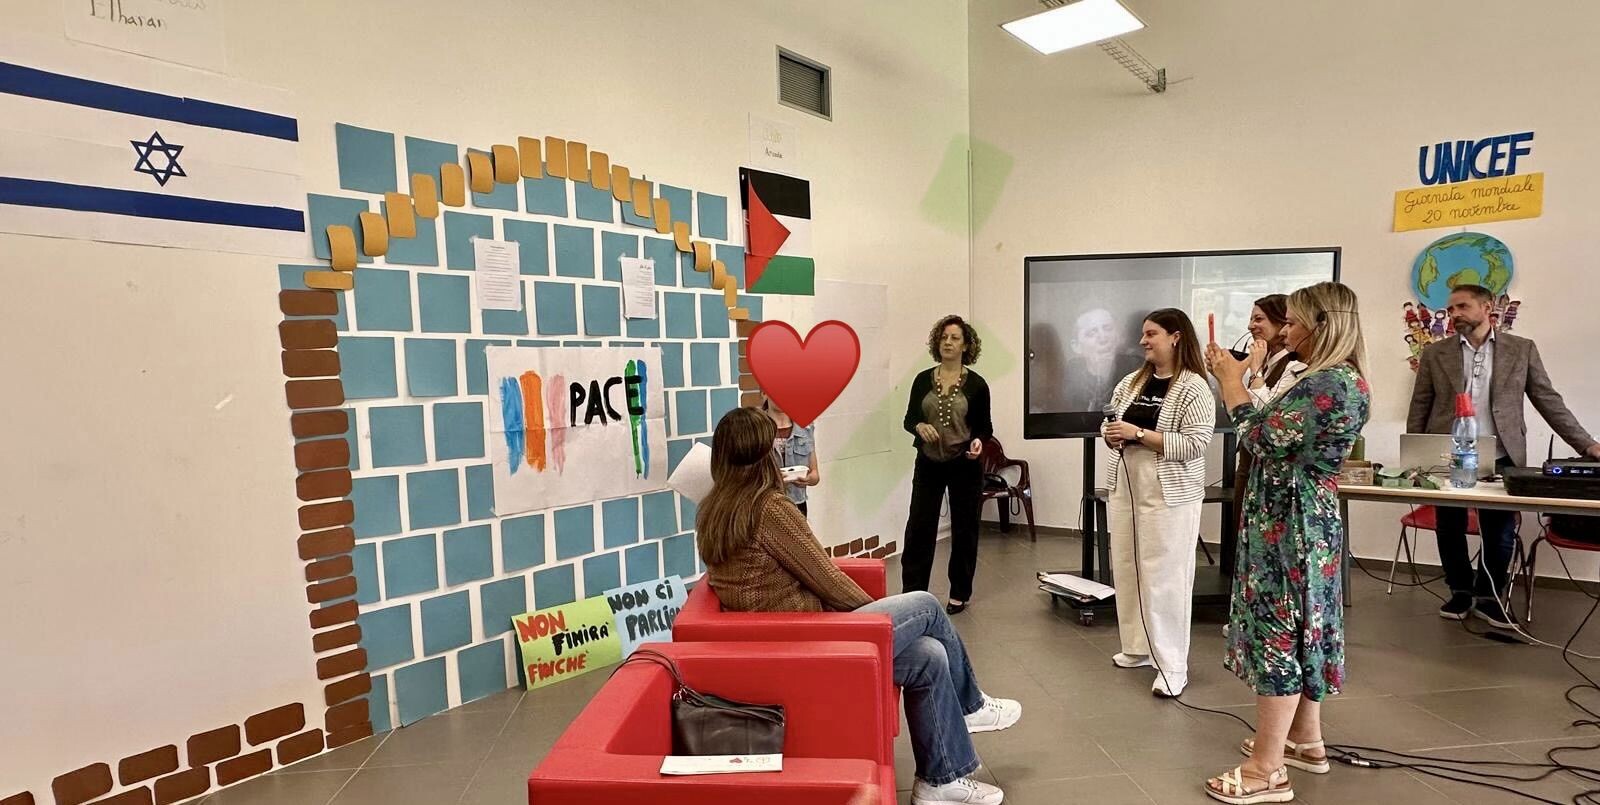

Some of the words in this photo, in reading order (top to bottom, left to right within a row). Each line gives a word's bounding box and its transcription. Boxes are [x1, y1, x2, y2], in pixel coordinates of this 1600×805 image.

[1419, 132, 1534, 185] UNICEF
[1404, 186, 1465, 213] Giornata
[1471, 175, 1535, 198] mondiale
[1423, 210, 1442, 224] 20
[1450, 197, 1520, 219] novembre
[570, 375, 645, 427] PACE
[607, 588, 649, 614] NON
[516, 609, 567, 643] NON
